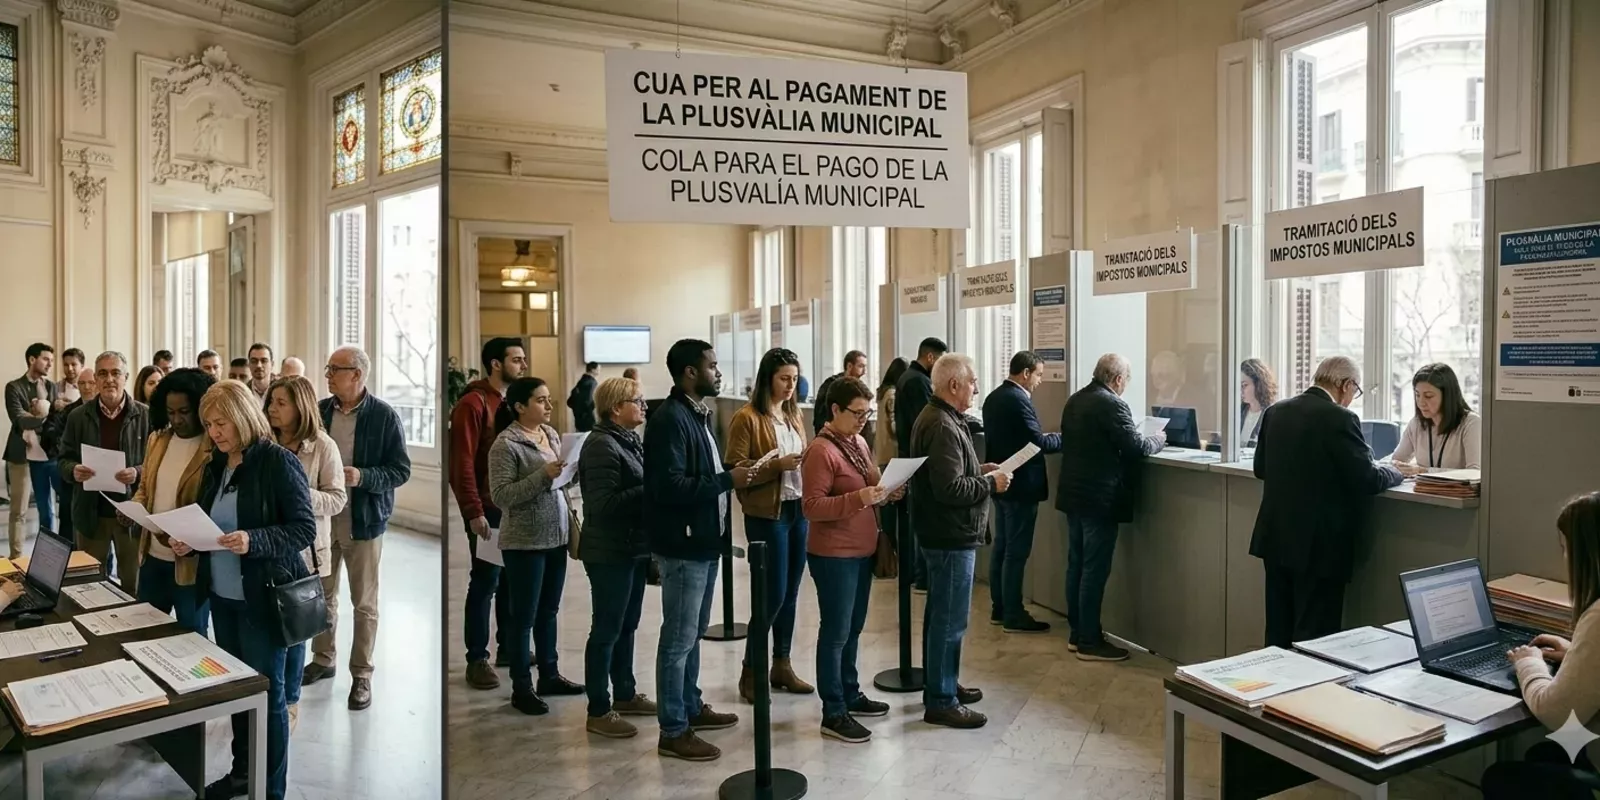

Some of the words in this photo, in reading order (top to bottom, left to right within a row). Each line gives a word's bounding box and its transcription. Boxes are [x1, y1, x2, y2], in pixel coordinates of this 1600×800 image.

[633, 70, 687, 96] CUA
[693, 74, 742, 99] PER
[747, 78, 779, 101] AL
[785, 80, 912, 109] PAGAMENT
[918, 88, 947, 111] DE
[642, 102, 675, 126] LA
[682, 103, 815, 132] PLUSVÀLIA
[821, 113, 942, 139] MUNICIPAL
[641, 148, 708, 173] COLA
[714, 151, 777, 175] PARA
[782, 153, 810, 177] EL
[816, 155, 879, 179] PAGO
[886, 158, 915, 180] DE
[922, 160, 949, 182] LA
[670, 178, 799, 206] PLUSVALÍA
[805, 183, 925, 209] MUNICIPAL
[1283, 214, 1358, 242] TRAMITACIÓ
[1361, 211, 1398, 231] DELS
[1153, 245, 1177, 260] DELS
[1270, 241, 1330, 262] IMPOSTOS
[1333, 231, 1415, 256] MUNICIPALS
